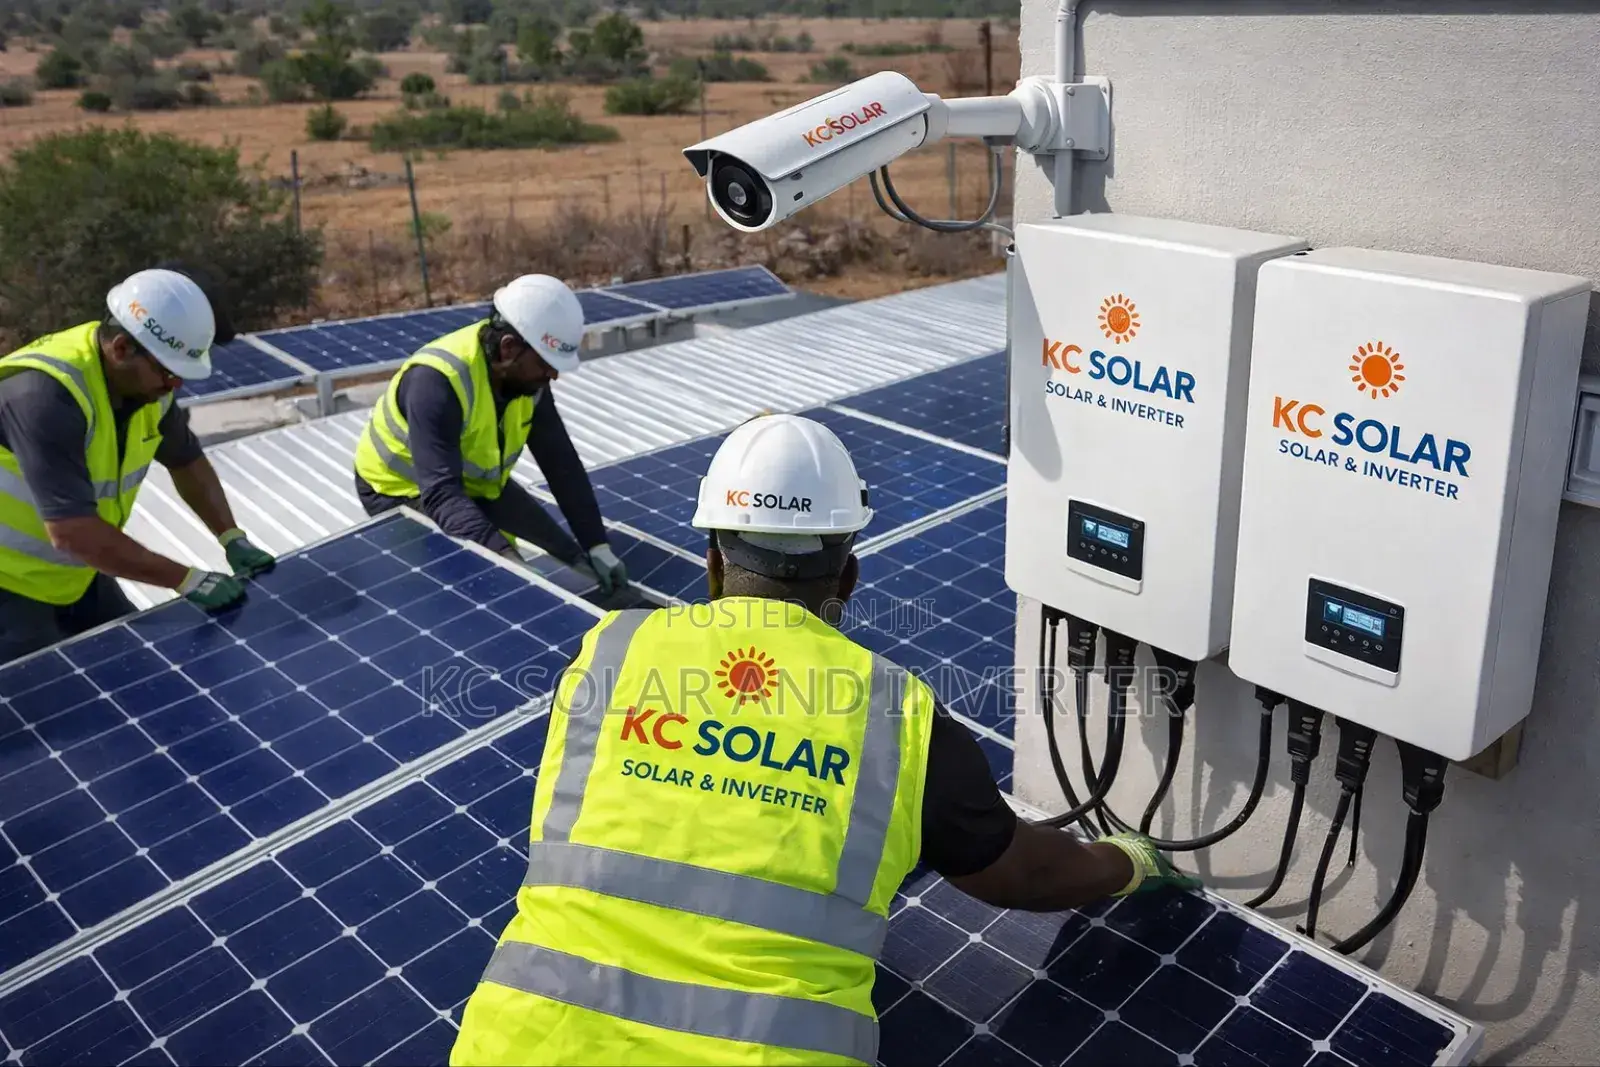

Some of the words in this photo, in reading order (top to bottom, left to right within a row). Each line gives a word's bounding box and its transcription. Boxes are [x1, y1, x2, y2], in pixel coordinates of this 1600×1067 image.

[827, 101, 887, 135] SOLAR
[128, 300, 148, 322] KC
[143, 317, 185, 352] SOLAR
[1041, 338, 1083, 374] KC
[1088, 350, 1196, 404] SOLAR
[1045, 380, 1093, 405] SOLAR
[1097, 394, 1107, 409] &
[1111, 397, 1185, 429] INVERTER
[1272, 396, 1325, 439] KC
[1331, 412, 1472, 478] SOLAR
[1278, 439, 1339, 467] SOLAR
[1344, 456, 1358, 473] &
[1363, 461, 1459, 500] INVERTER
[726, 490, 750, 507] KC
[752, 493, 812, 513] SOLAR
[620, 705, 689, 750] KC
[692, 719, 851, 786] SOLAR
[621, 759, 694, 788] SOLAR
[699, 774, 715, 792] &
[721, 777, 828, 816] INVERTER
